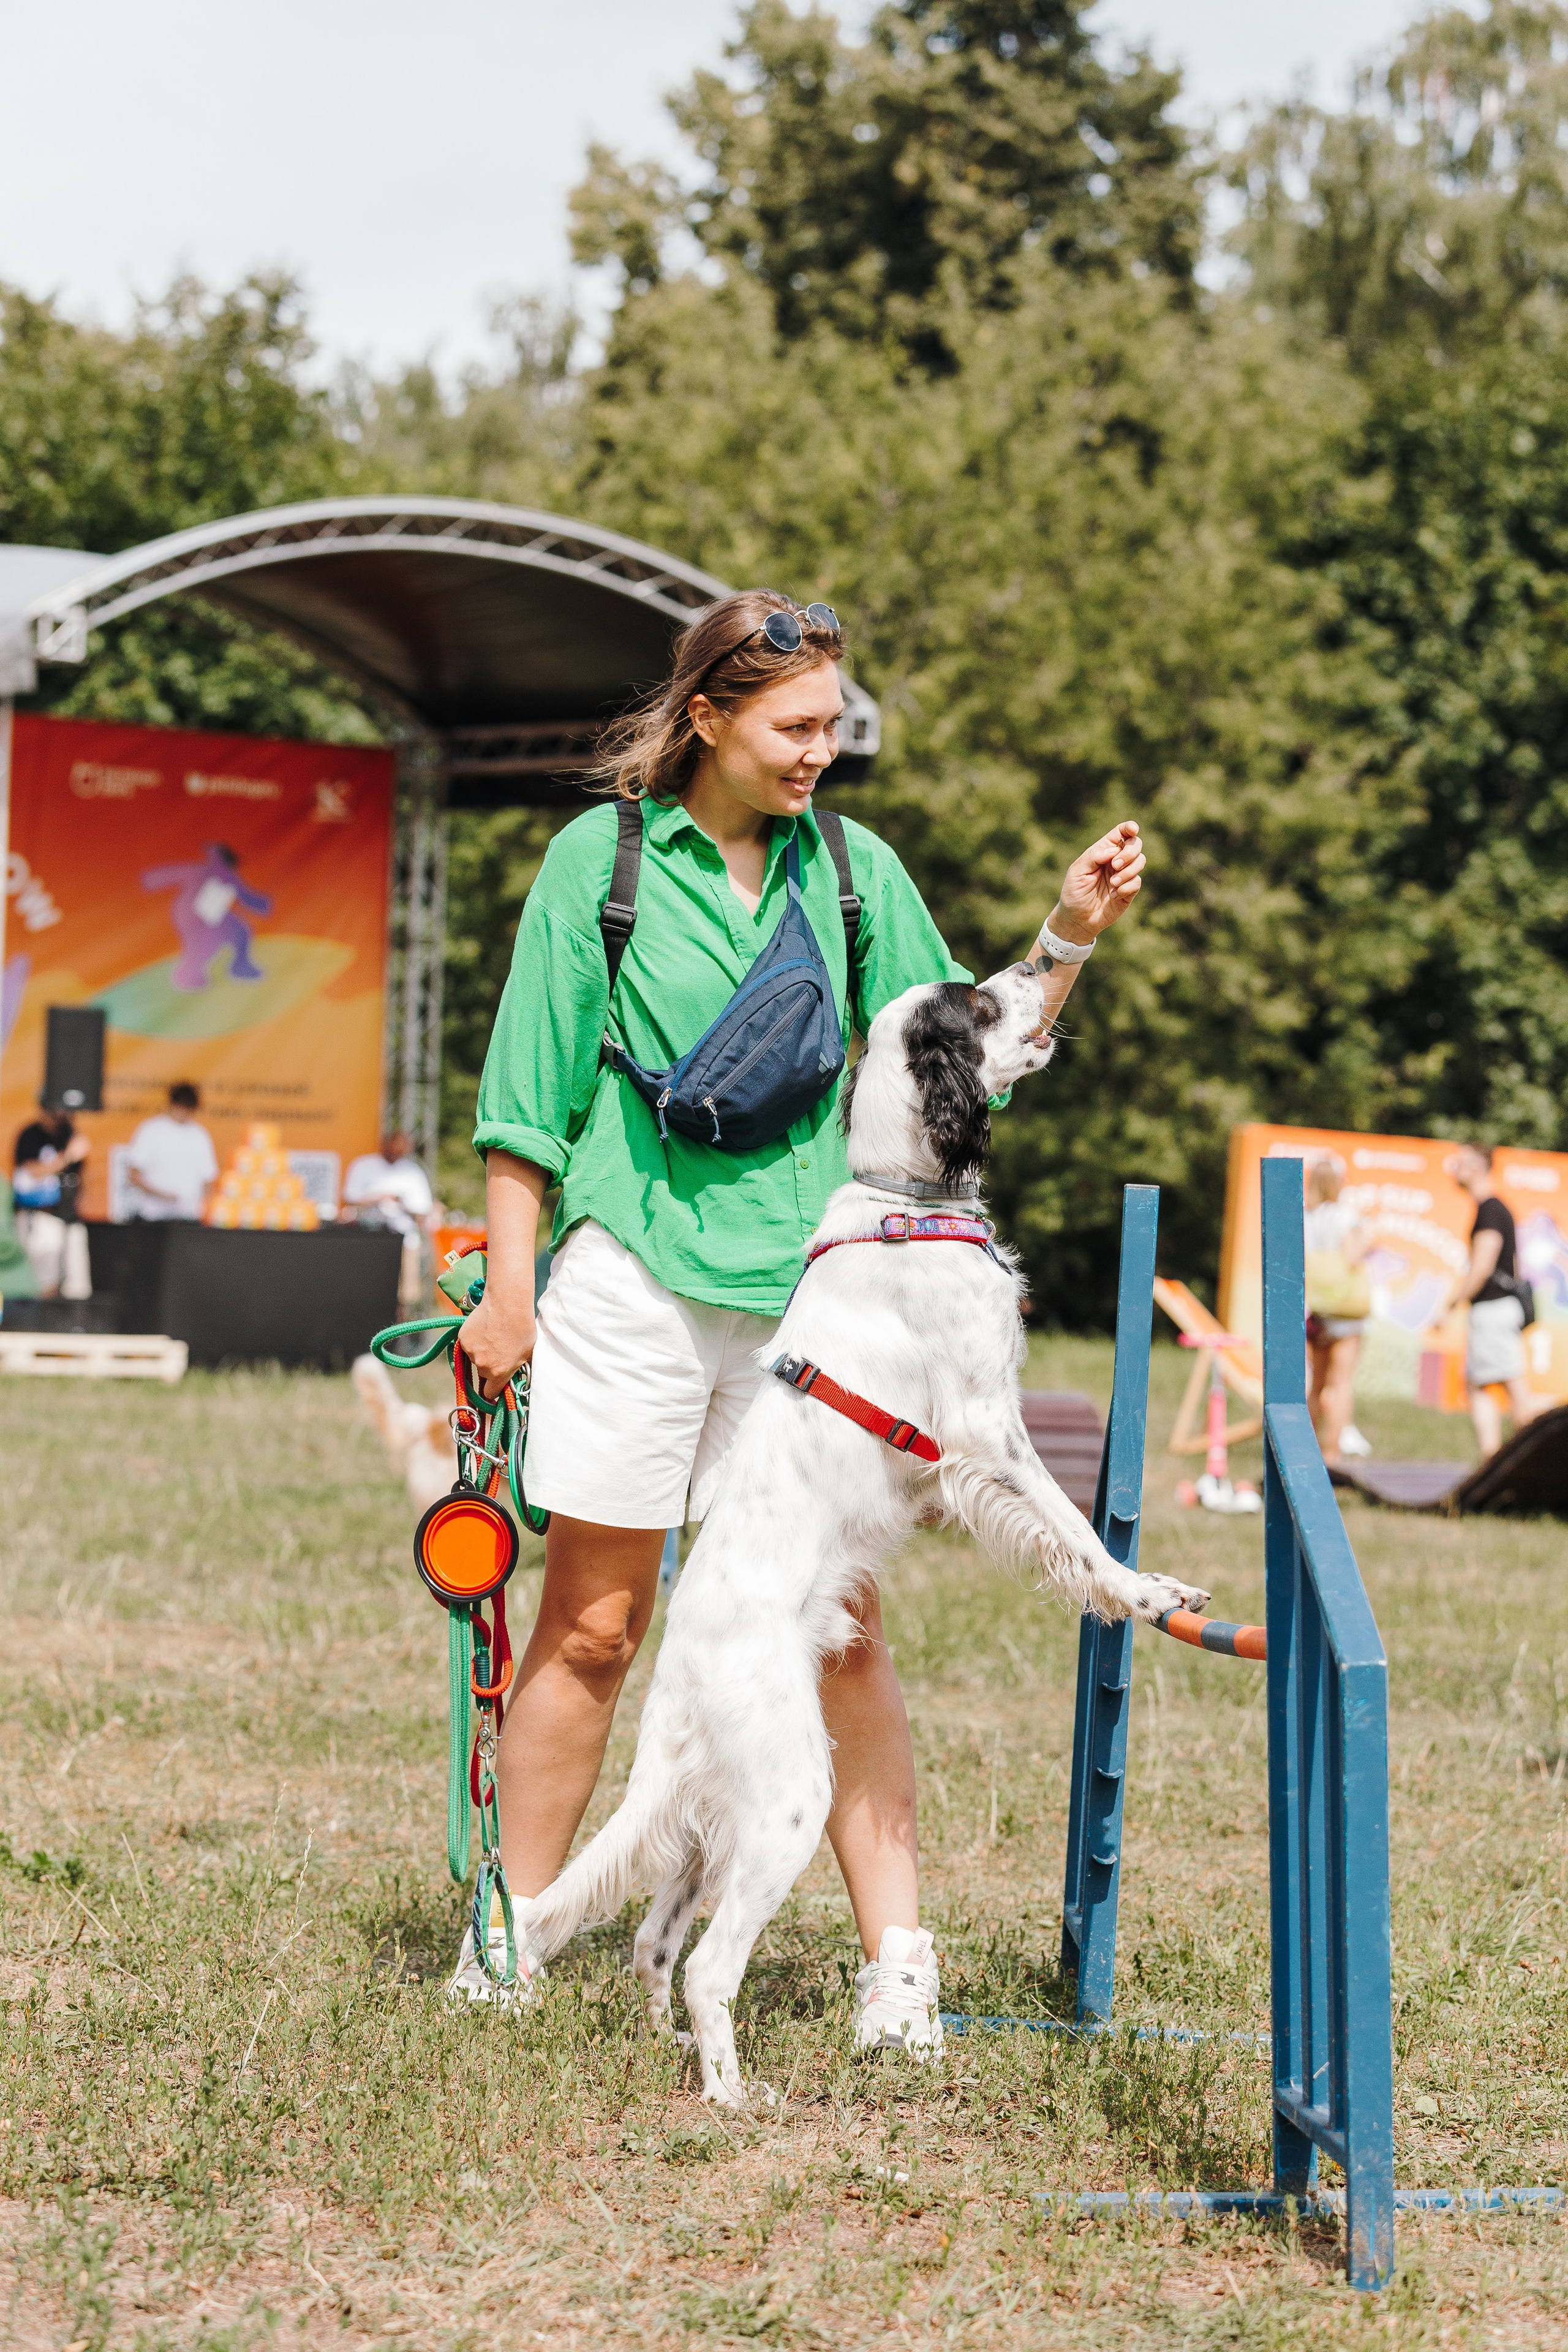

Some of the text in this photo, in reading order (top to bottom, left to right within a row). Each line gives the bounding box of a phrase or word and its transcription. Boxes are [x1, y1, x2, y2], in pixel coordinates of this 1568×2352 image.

[821, 1058, 837, 1084] deuter
[917, 1219, 938, 1231] DOG
[914, 1939, 927, 1958] THX!
